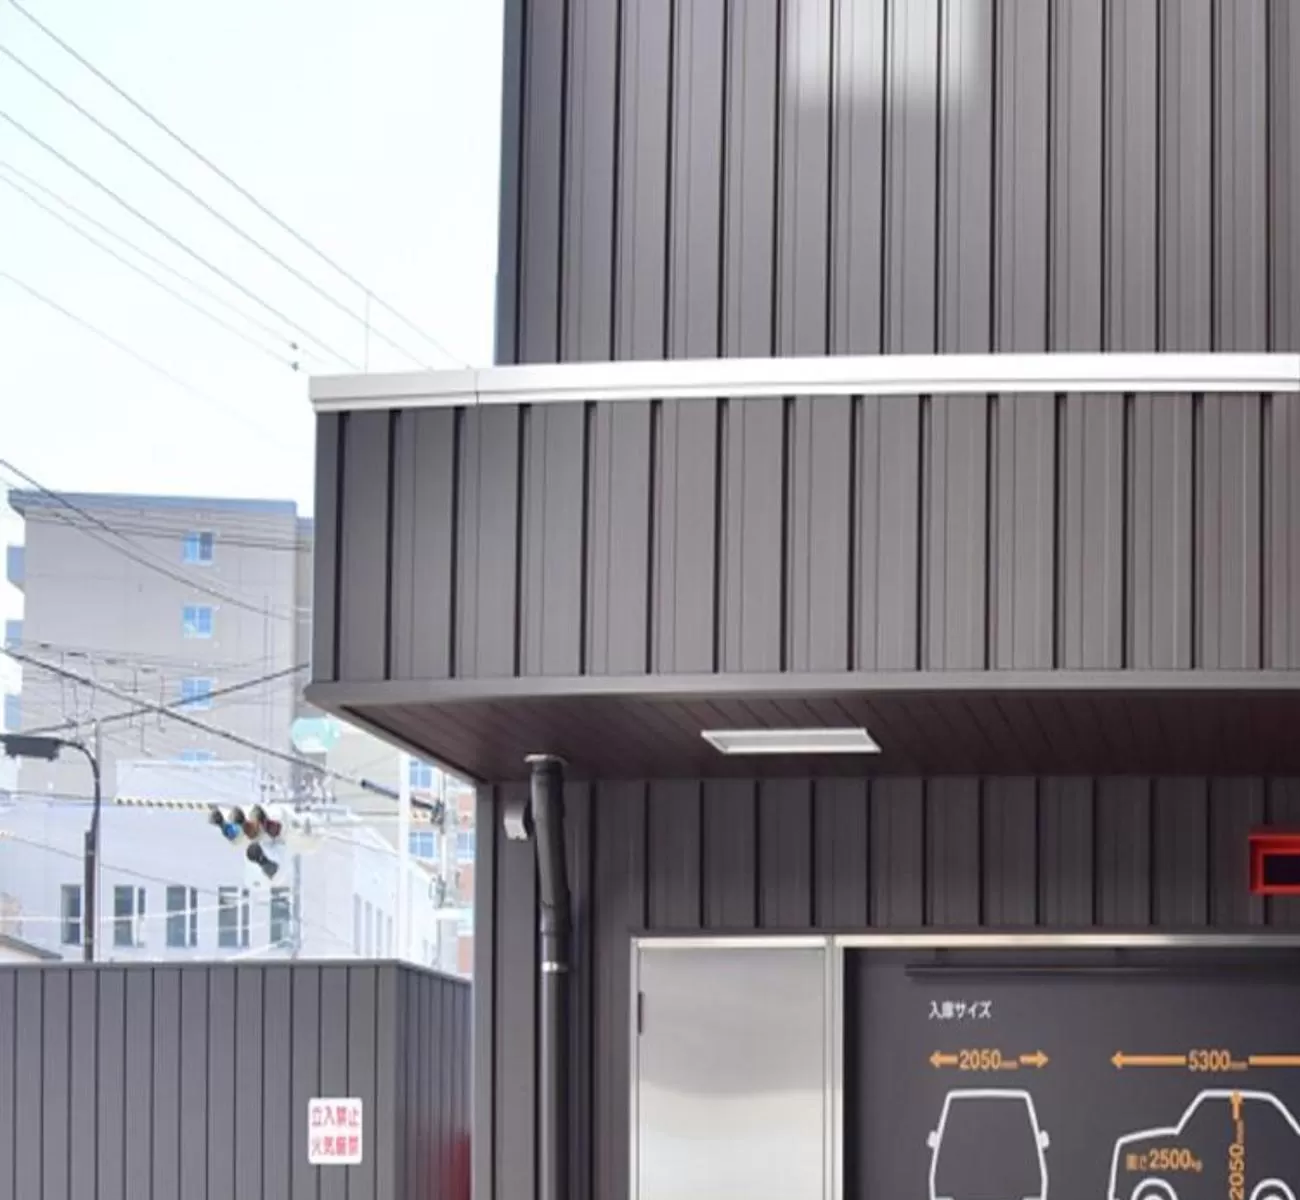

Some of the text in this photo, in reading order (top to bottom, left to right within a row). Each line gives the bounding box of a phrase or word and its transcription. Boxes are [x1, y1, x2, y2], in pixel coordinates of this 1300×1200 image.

[312, 1105, 359, 1126] 立入禁止
[312, 1136, 359, 1156] 火気厳禁
